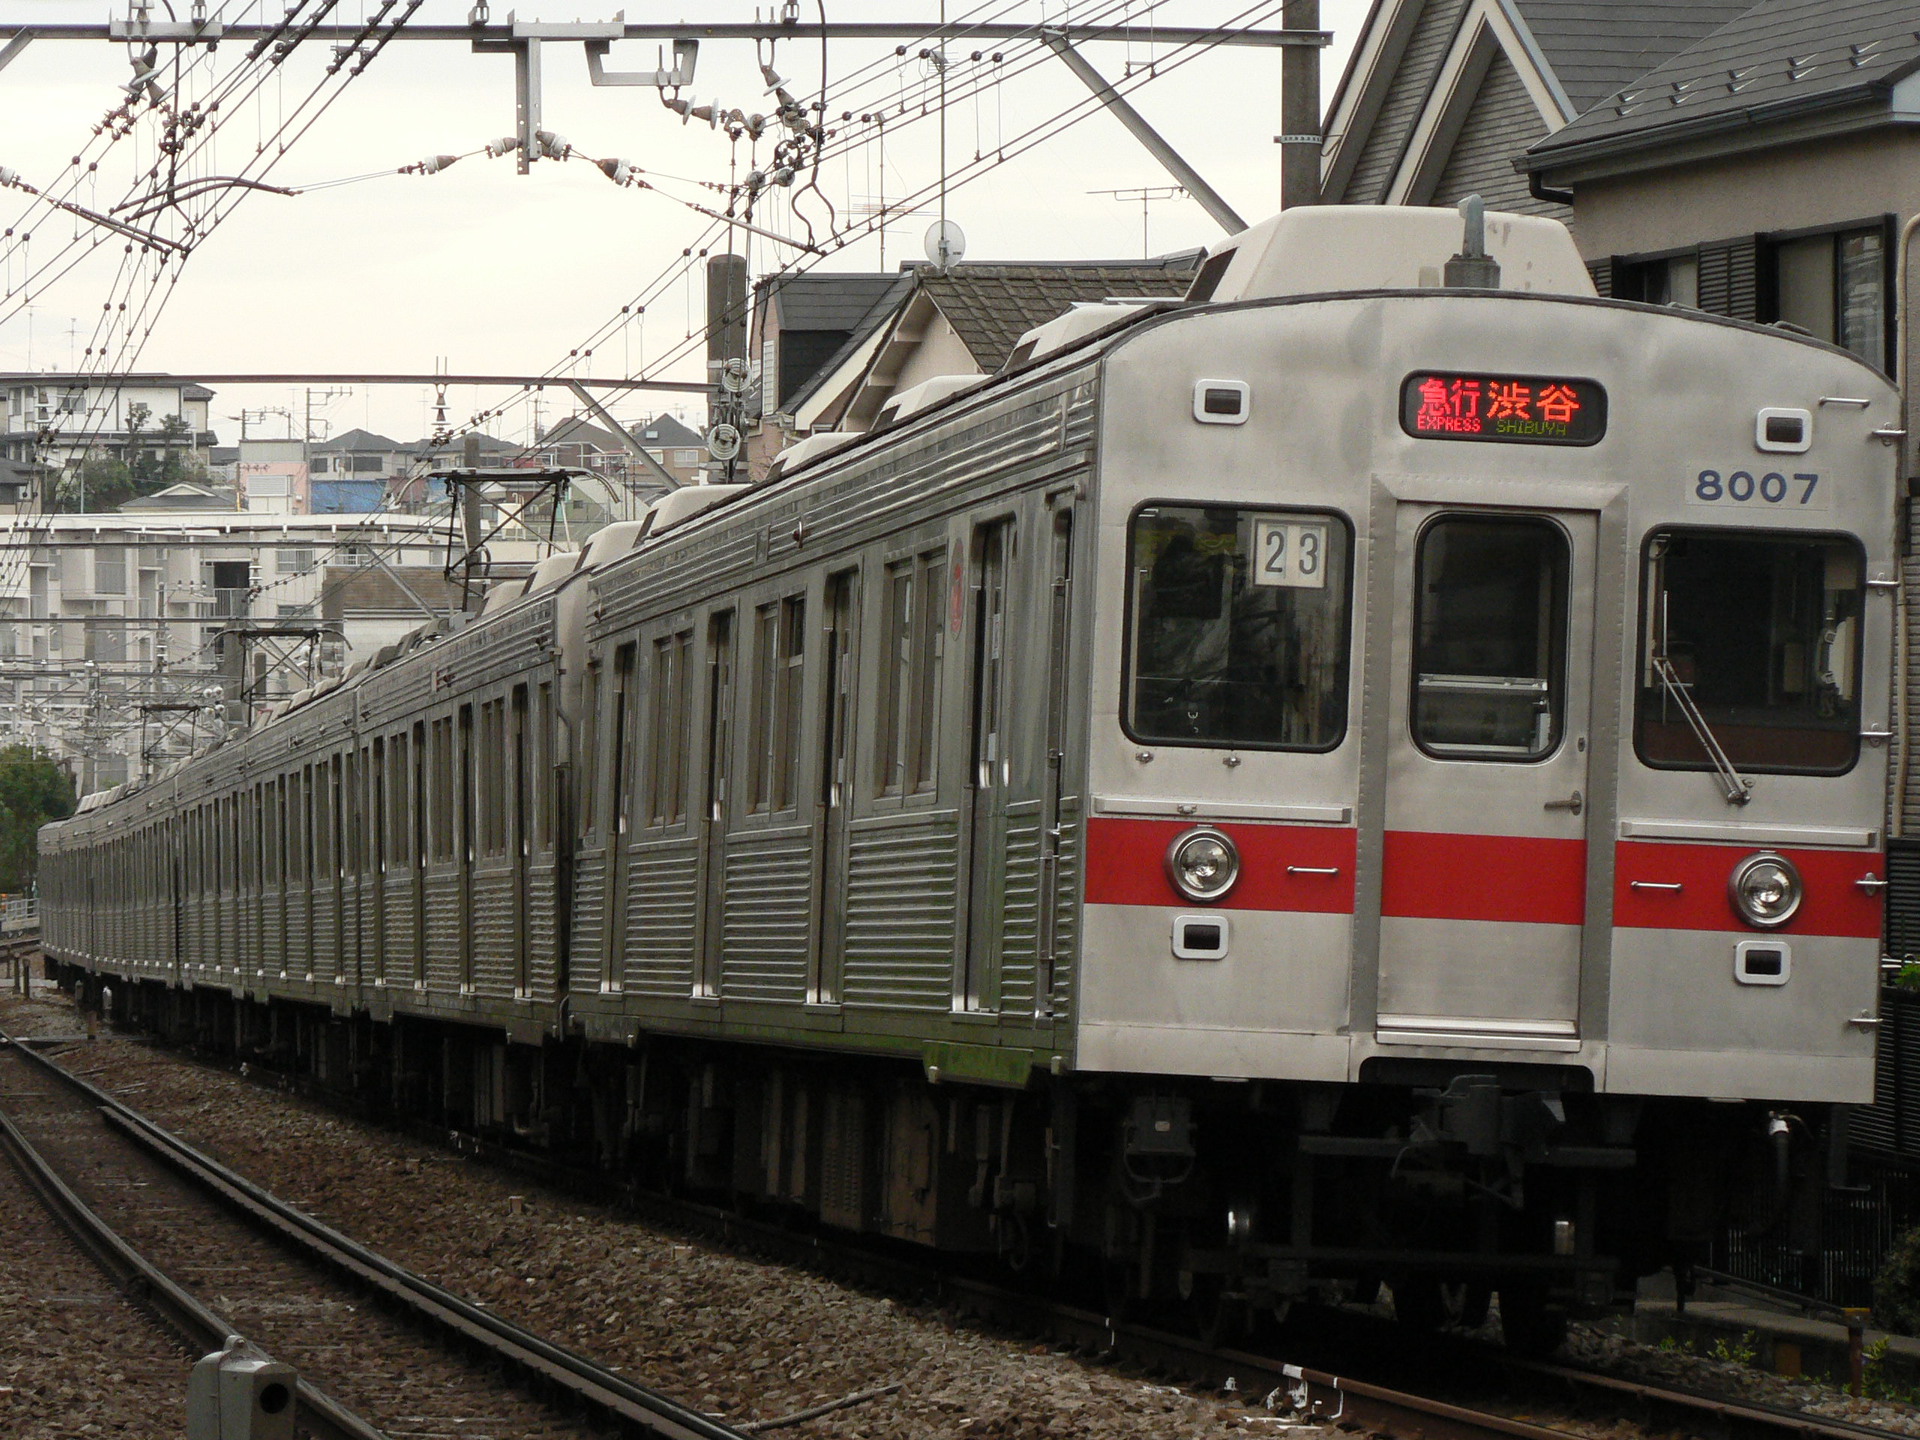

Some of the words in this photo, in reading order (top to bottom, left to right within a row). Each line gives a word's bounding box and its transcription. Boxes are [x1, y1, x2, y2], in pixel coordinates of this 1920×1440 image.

[1418, 377, 1481, 419] 急行
[1487, 382, 1580, 422] 渋谷
[1417, 415, 1481, 432] EXPRESS
[1496, 419, 1567, 436] SHIBUYA
[1696, 469, 1819, 504] 8007
